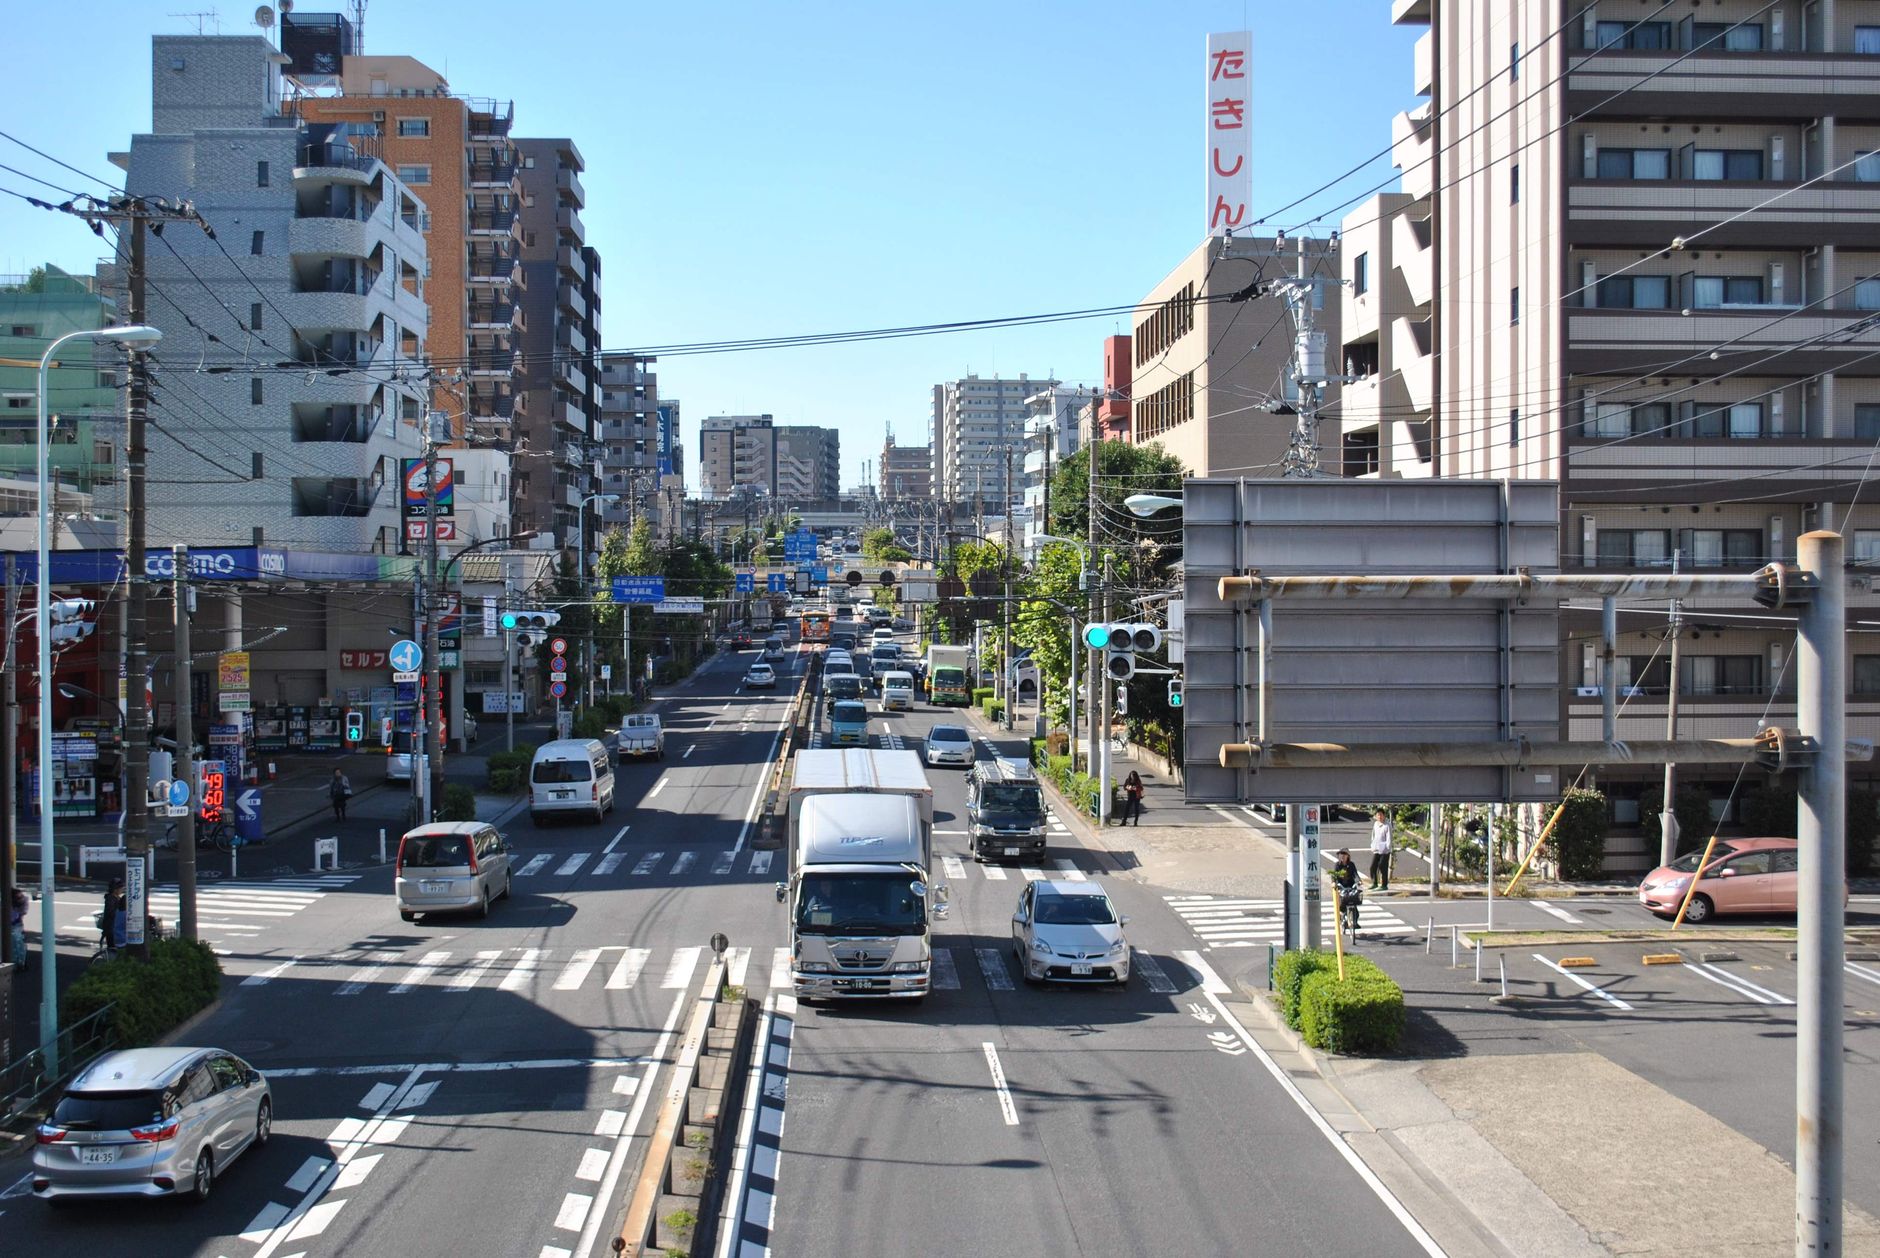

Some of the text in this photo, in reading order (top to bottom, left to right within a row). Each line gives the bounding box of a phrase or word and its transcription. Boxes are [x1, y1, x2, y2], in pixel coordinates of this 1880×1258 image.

[1211, 49, 1245, 229] たきしん
[145, 553, 236, 575] COMO
[261, 553, 285, 572] COSMO
[440, 639, 455, 648] 石油
[341, 651, 386, 667] セルフ
[205, 773, 223, 789] 49
[205, 790, 223, 805] 60
[89, 1153, 113, 1162] 44-35
